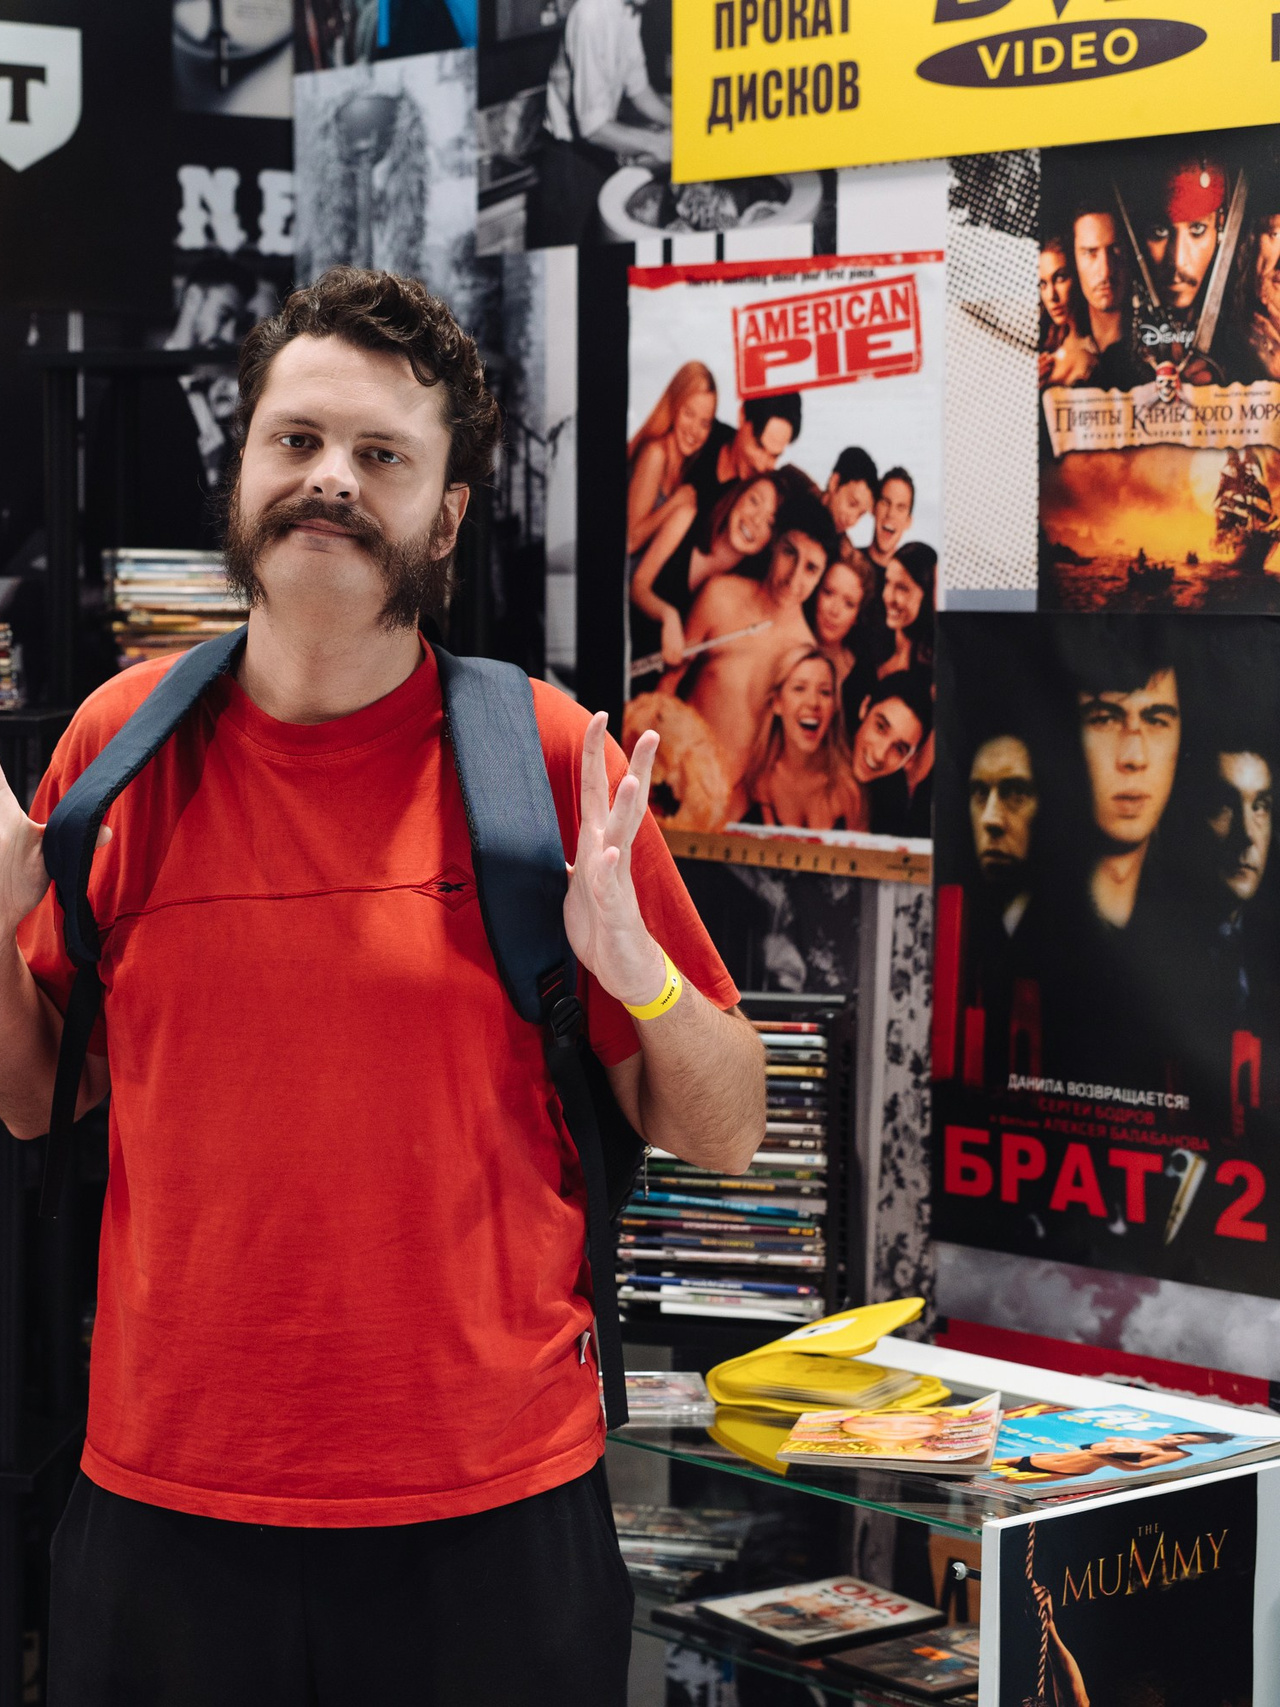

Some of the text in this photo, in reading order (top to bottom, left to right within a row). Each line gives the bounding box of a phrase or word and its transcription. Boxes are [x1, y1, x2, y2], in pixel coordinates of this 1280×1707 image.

[714, 0, 852, 50] ПРОКАТ
[977, 27, 1140, 80] VIDEO
[707, 60, 860, 134] ДИСКОВ
[742, 285, 910, 345] AMERICAN
[743, 319, 915, 388] PIE
[1008, 1073, 1190, 1111] ДАНИЛА ВОЗВРАЩАЕТСЯ!
[1095, 1104, 1156, 1126] БОДРОВ
[1110, 1125, 1210, 1151] БАЛАБАНОВА
[944, 1124, 1268, 1243] БРАТ 2
[1138, 1522, 1160, 1537] THE
[1062, 1528, 1228, 1606] MUMMY
